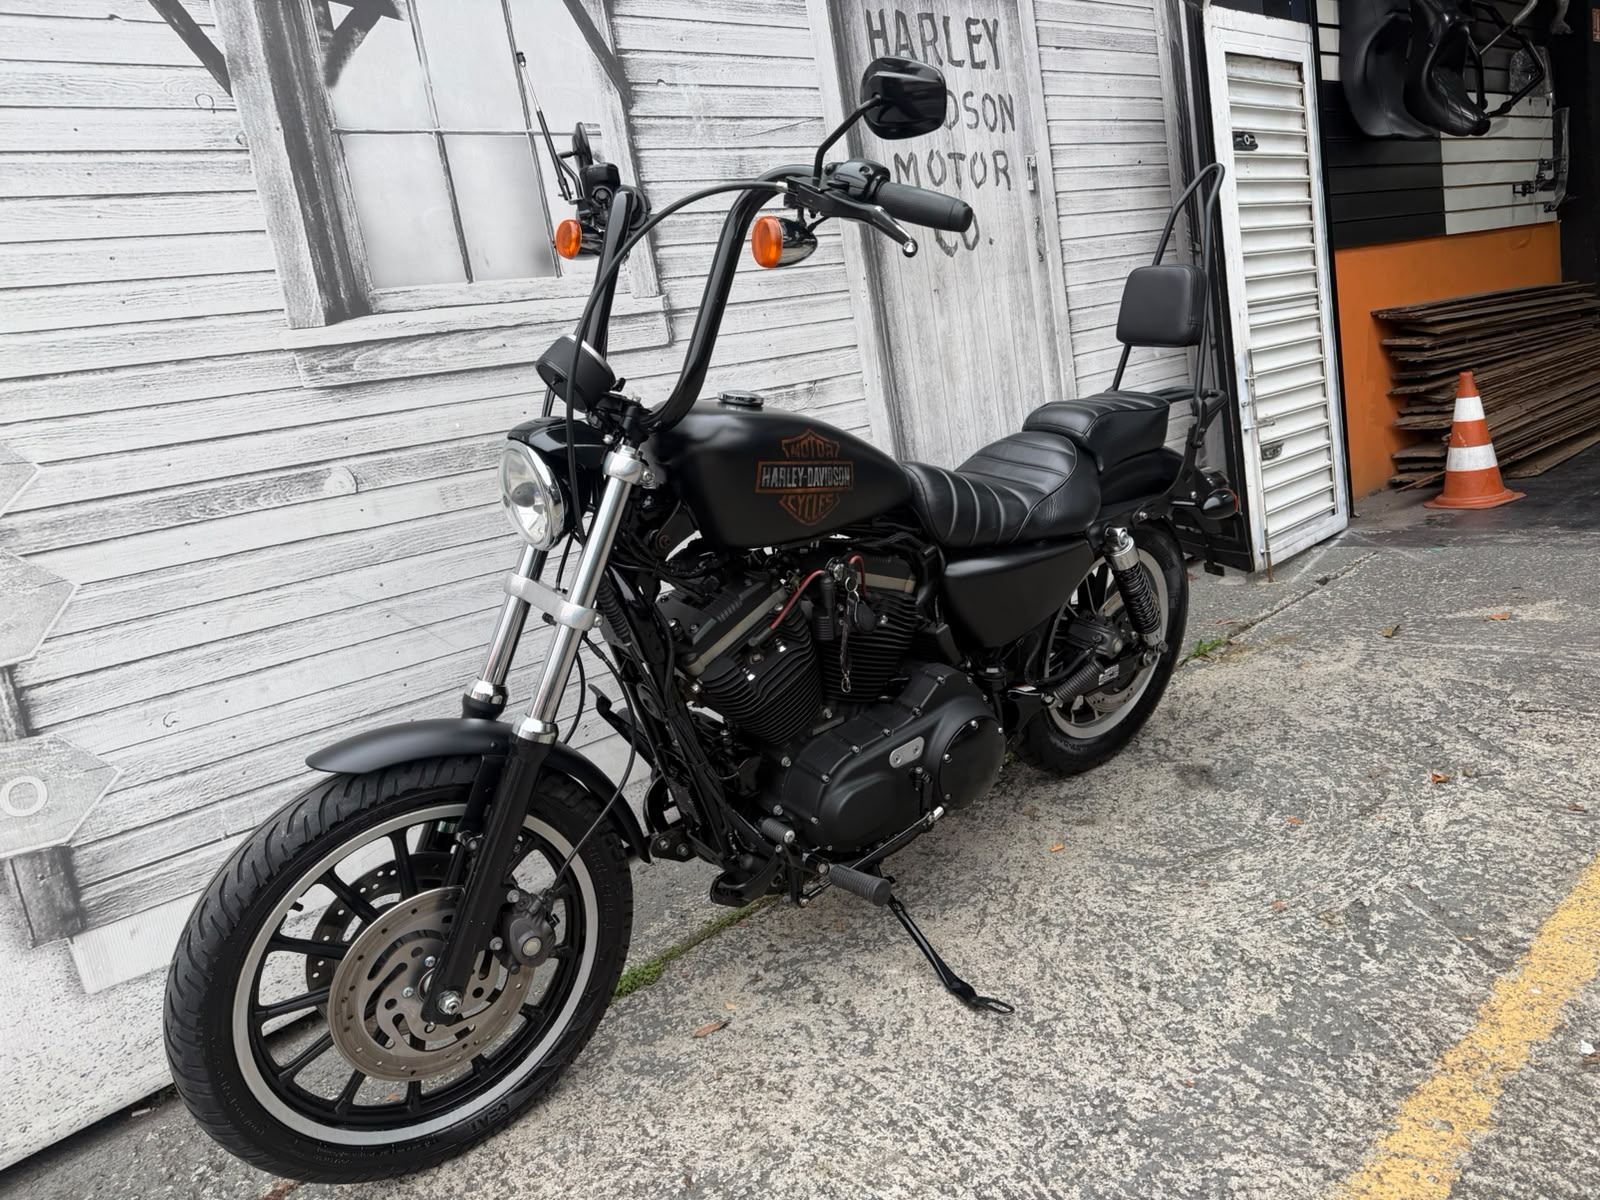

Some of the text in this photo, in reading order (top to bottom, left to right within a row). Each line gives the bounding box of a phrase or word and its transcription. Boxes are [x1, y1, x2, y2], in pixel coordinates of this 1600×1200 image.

[866, 8, 1000, 70] HARLEY
[945, 89, 1015, 133] DSON
[894, 149, 1011, 191] MOTOR
[790, 437, 834, 458] MOTOR
[761, 465, 851, 488] HARLEY-DAVIDSON
[787, 494, 834, 520] CYCLES
